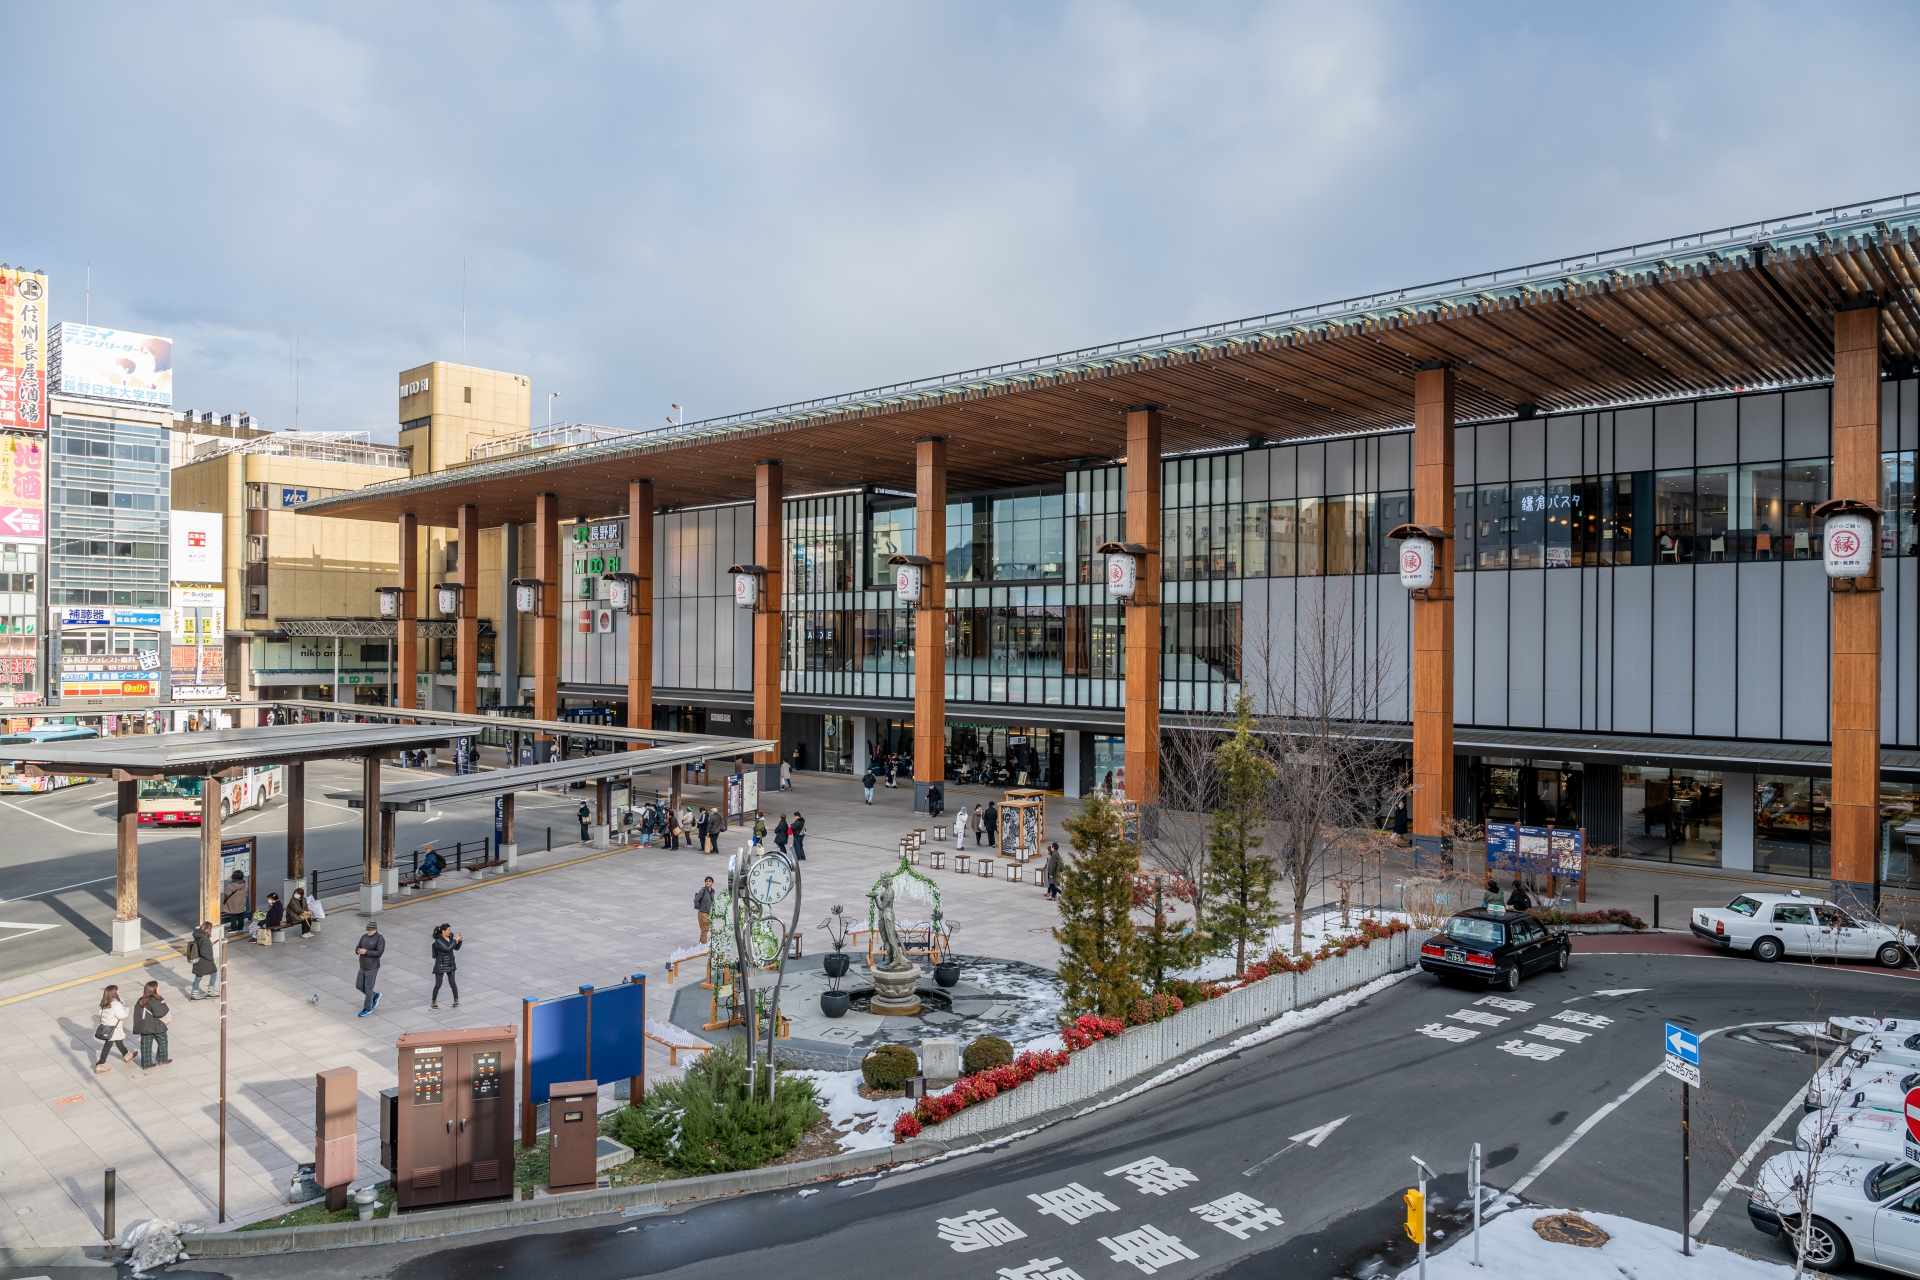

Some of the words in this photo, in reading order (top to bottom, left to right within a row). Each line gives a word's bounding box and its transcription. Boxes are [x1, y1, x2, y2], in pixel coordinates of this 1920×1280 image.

[64, 324, 115, 340] ミライ
[20, 304, 39, 422] 信州長屋酒場
[63, 380, 171, 404] 長野日本大学学園
[13, 442, 42, 500] 地酒
[1521, 494, 1581, 512] 鎌倉パスタ
[572, 527, 589, 544] JR
[590, 524, 618, 541] 長野駅
[1833, 535, 1855, 553] 縁
[1403, 555, 1417, 569] 縁
[68, 609, 105, 620] 補聴器
[74, 656, 136, 664] 長野フォレスト歯科
[137, 650, 161, 671] 歯
[301, 649, 321, 657] niko
[123, 683, 147, 693] Daily
[1415, 995, 1537, 1043] 降車場
[1496, 1009, 1615, 1061] 駐車場
[936, 1156, 1200, 1253] 降車場
